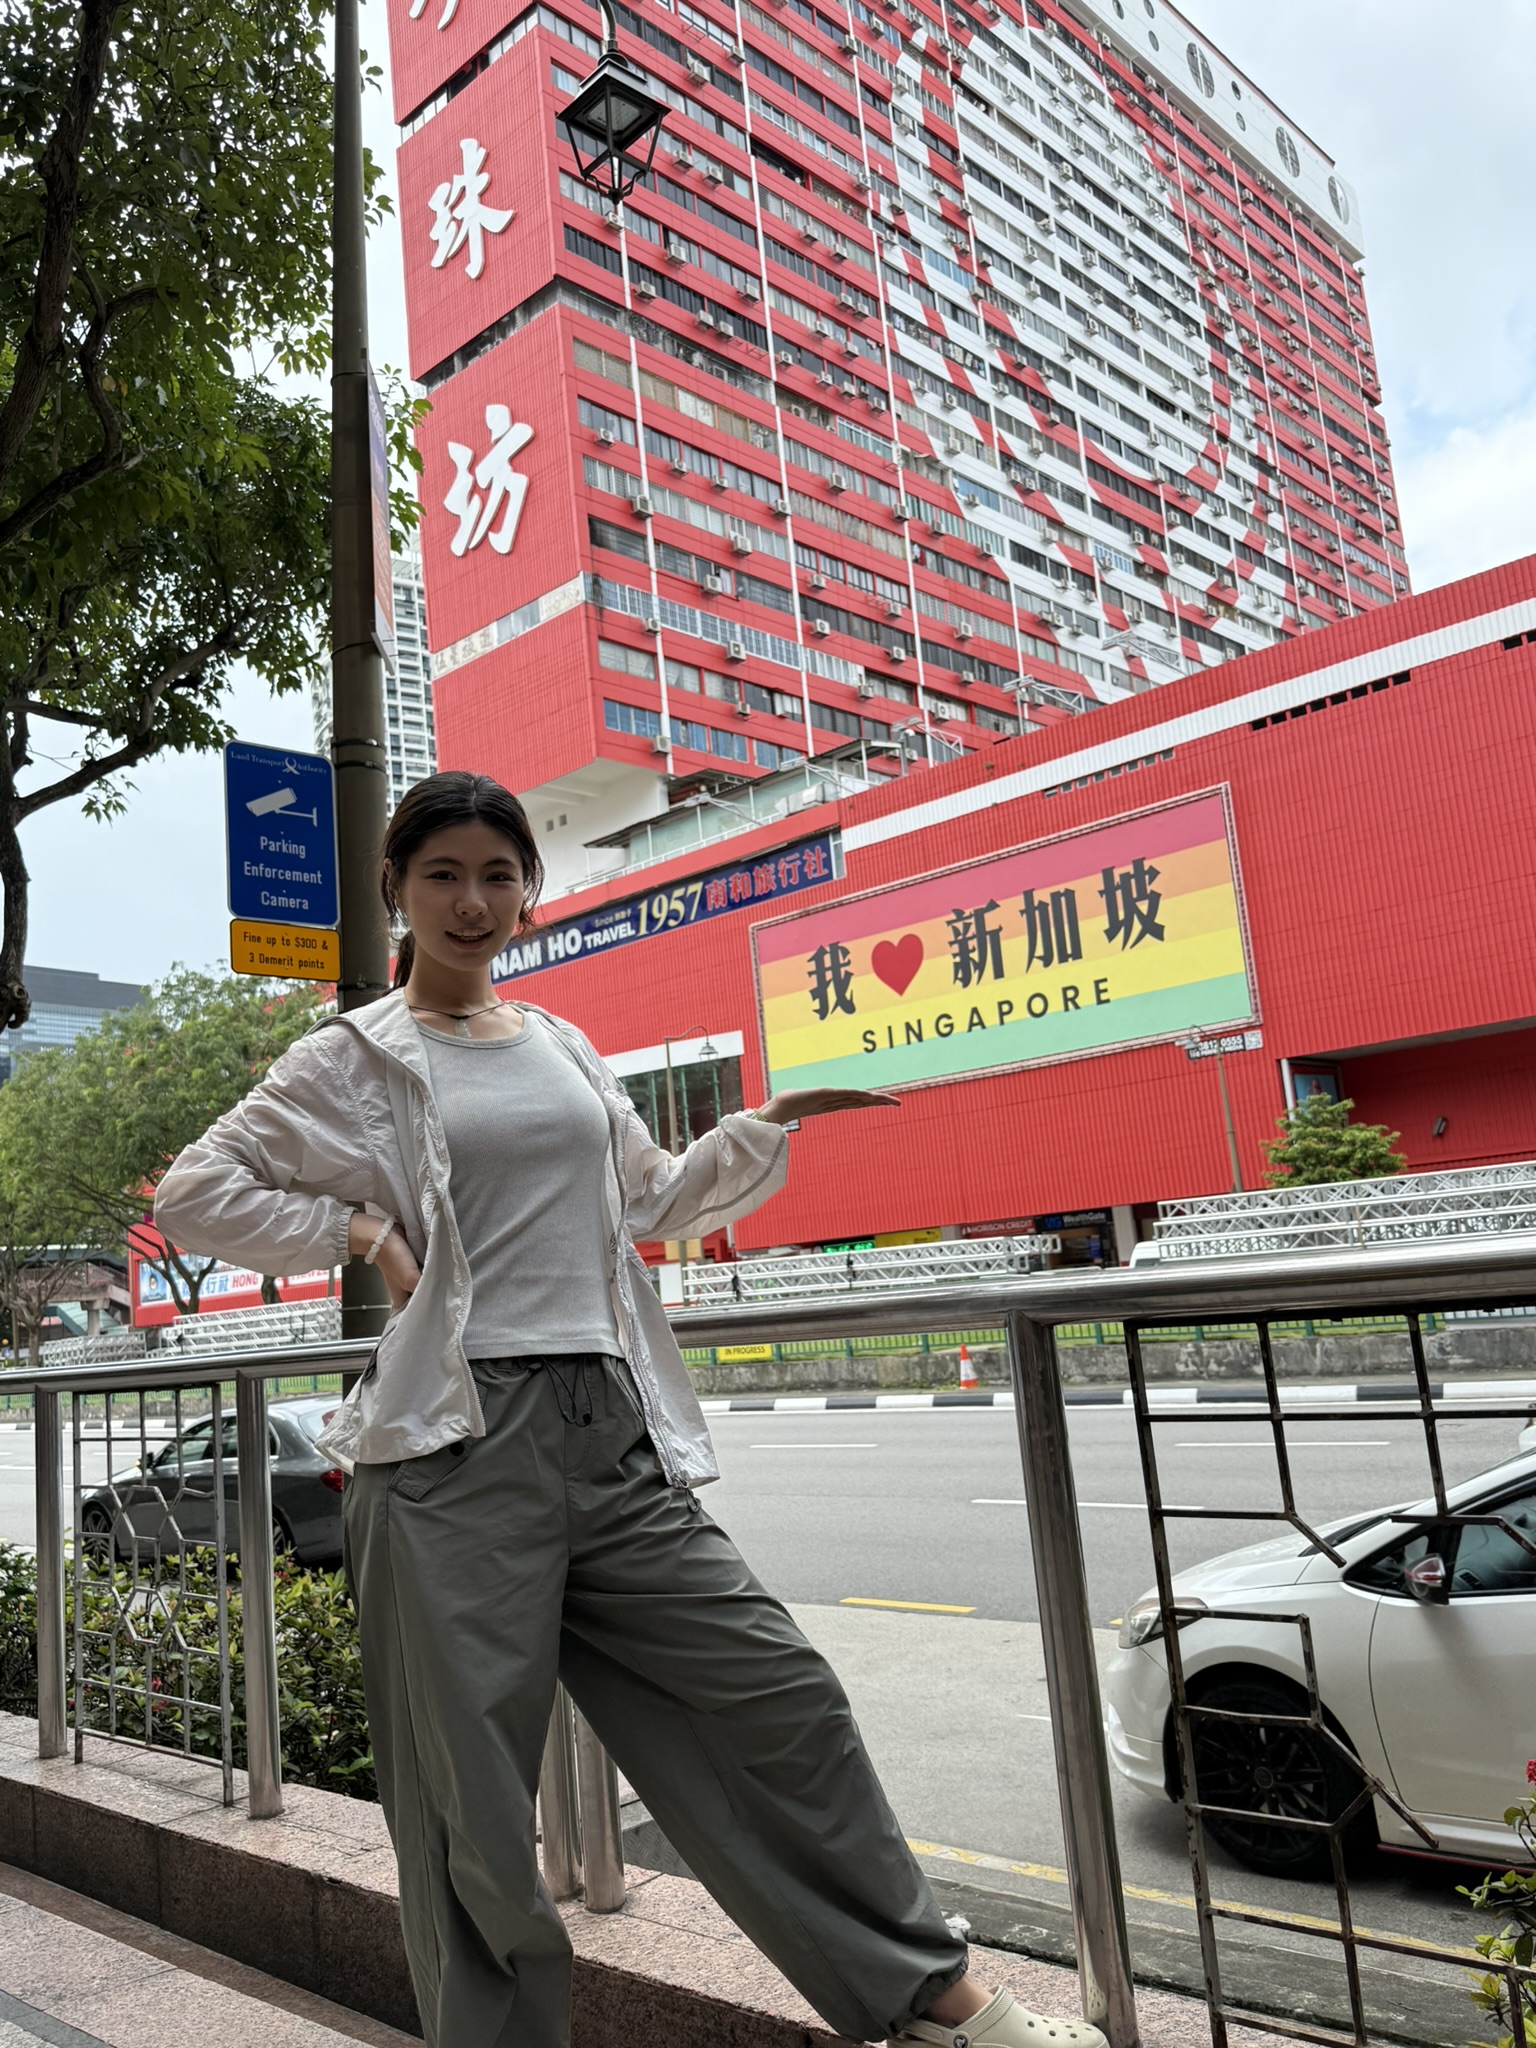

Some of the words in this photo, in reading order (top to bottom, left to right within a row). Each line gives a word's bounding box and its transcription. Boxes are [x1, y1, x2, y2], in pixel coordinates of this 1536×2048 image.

[231, 751, 250, 761] Land
[251, 754, 285, 767] Transport
[297, 763, 327, 775] Authority
[260, 836, 306, 859] Parking
[244, 861, 323, 885] Enforcement
[705, 845, 829, 912] 南和旅行社
[261, 890, 309, 910] Camera
[243, 932, 262, 943] Fine
[266, 936, 277, 947] up
[281, 936, 291, 946] to
[295, 937, 317, 949] $300
[321, 940, 328, 950] &
[492, 940, 543, 980] NAM
[547, 928, 583, 962] HO
[584, 922, 636, 949] TRAVEL
[636, 881, 704, 937] 1957
[806, 941, 856, 1021] 我
[945, 857, 1165, 989] 新加坡
[249, 952, 255, 963] 3
[259, 953, 294, 966] Demerit
[298, 958, 325, 970] points
[862, 977, 1111, 1054] SINGAPORE
[1006, 1219, 1033, 1229] CREDIT
[1062, 1212, 1106, 1224] WealthGate
[232, 1273, 259, 1288] HONG
[733, 1346, 765, 1355] PROGRESS
